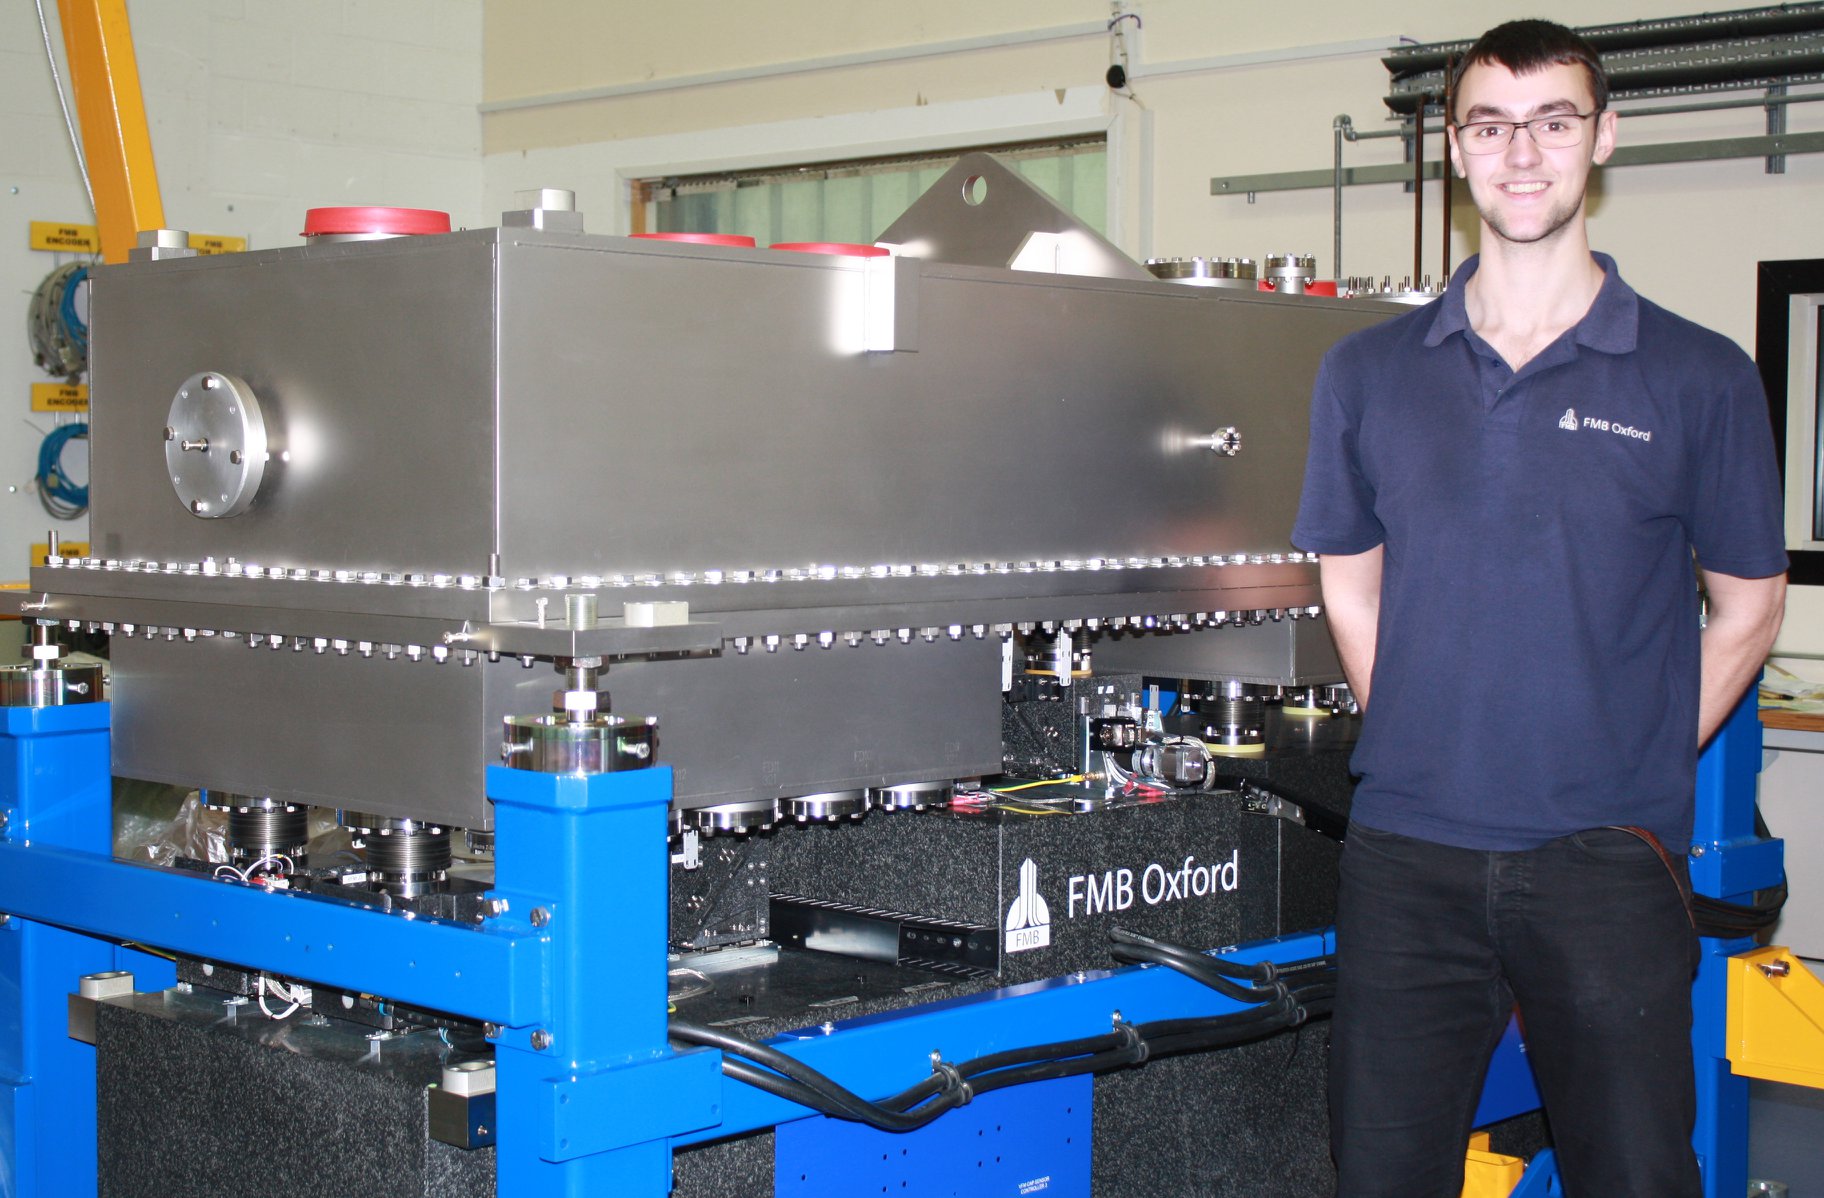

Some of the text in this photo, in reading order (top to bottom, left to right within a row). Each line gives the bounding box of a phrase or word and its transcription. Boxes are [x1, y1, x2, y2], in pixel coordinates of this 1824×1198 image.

[58, 228, 78, 236] FMB
[46, 236, 90, 247] ENCODER
[59, 389, 79, 397] FMB
[1583, 417, 1652, 443] FMB Oxford
[1068, 849, 1239, 918] FMB Oxford
[1015, 929, 1041, 948] FMB
[1020, 1183, 1045, 1195] CONTROLLER
